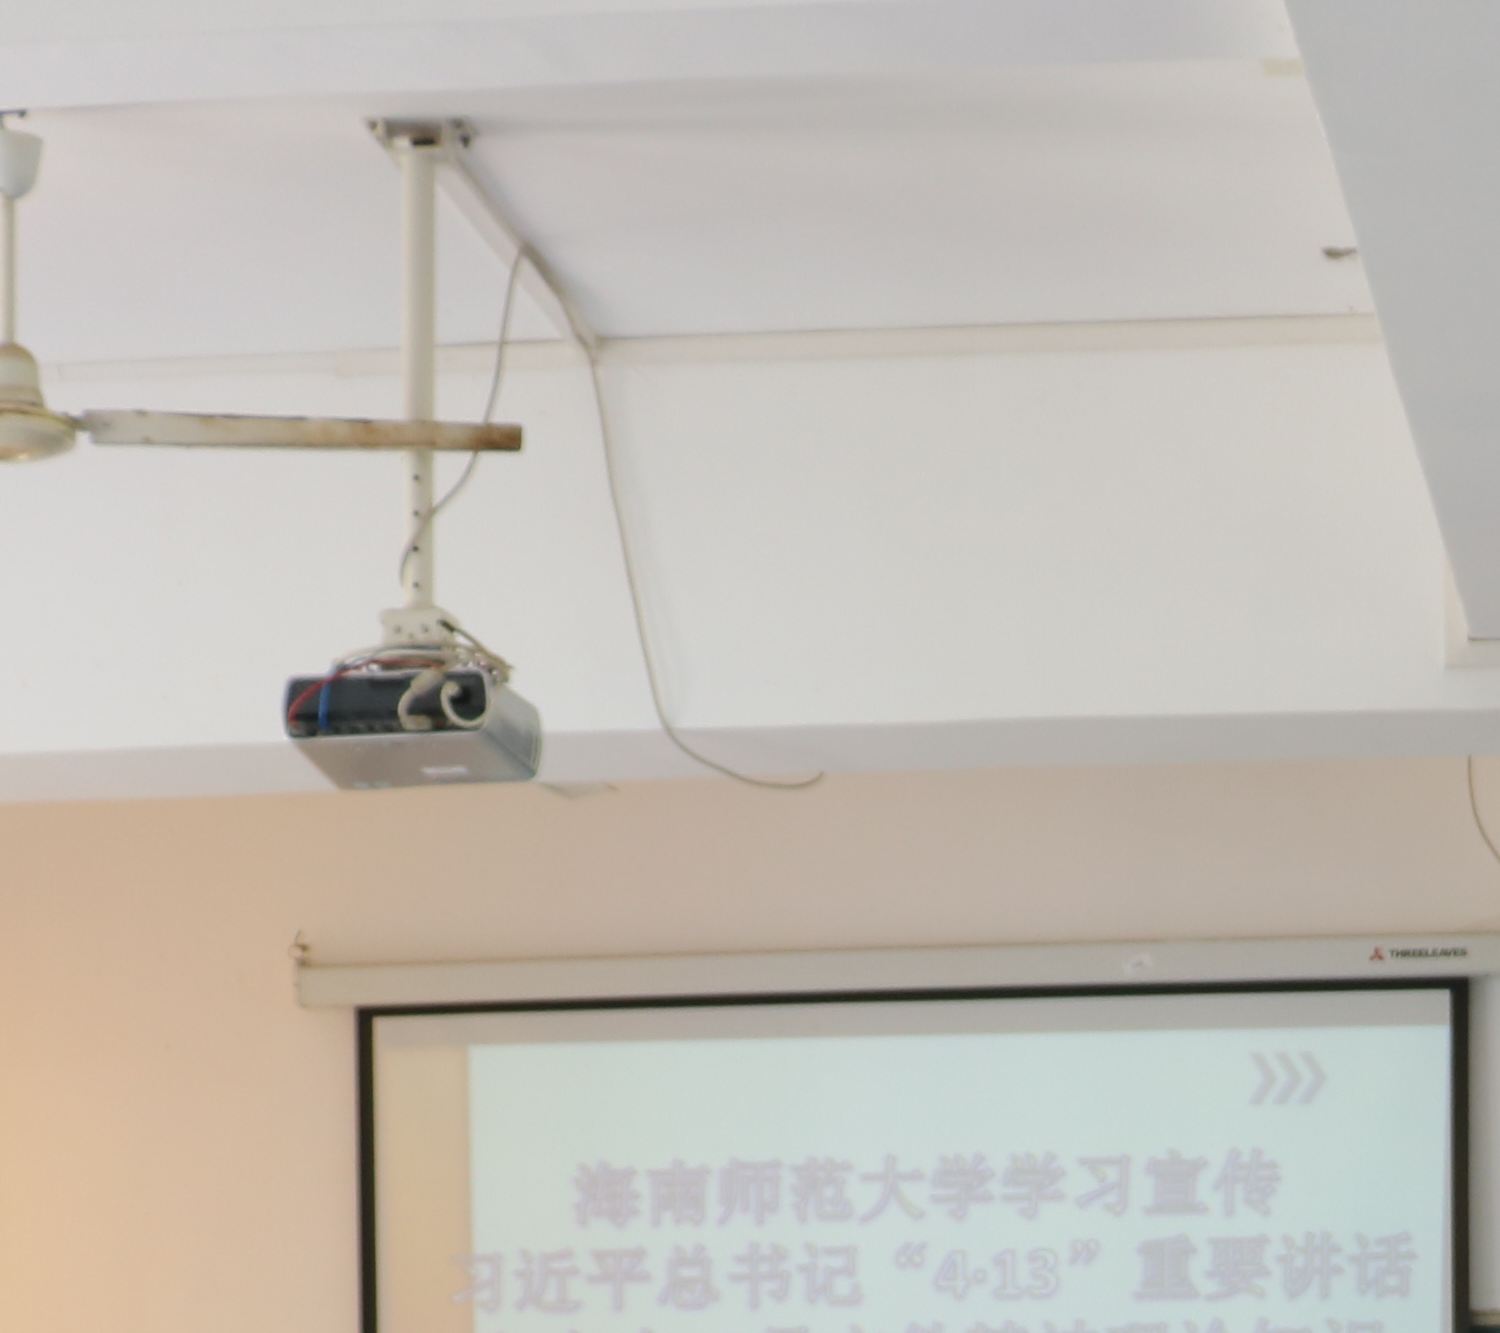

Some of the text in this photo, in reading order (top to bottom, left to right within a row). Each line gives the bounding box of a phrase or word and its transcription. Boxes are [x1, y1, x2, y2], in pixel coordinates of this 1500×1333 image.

[571, 1148, 1285, 1230] 海南师范大学学习宣传
